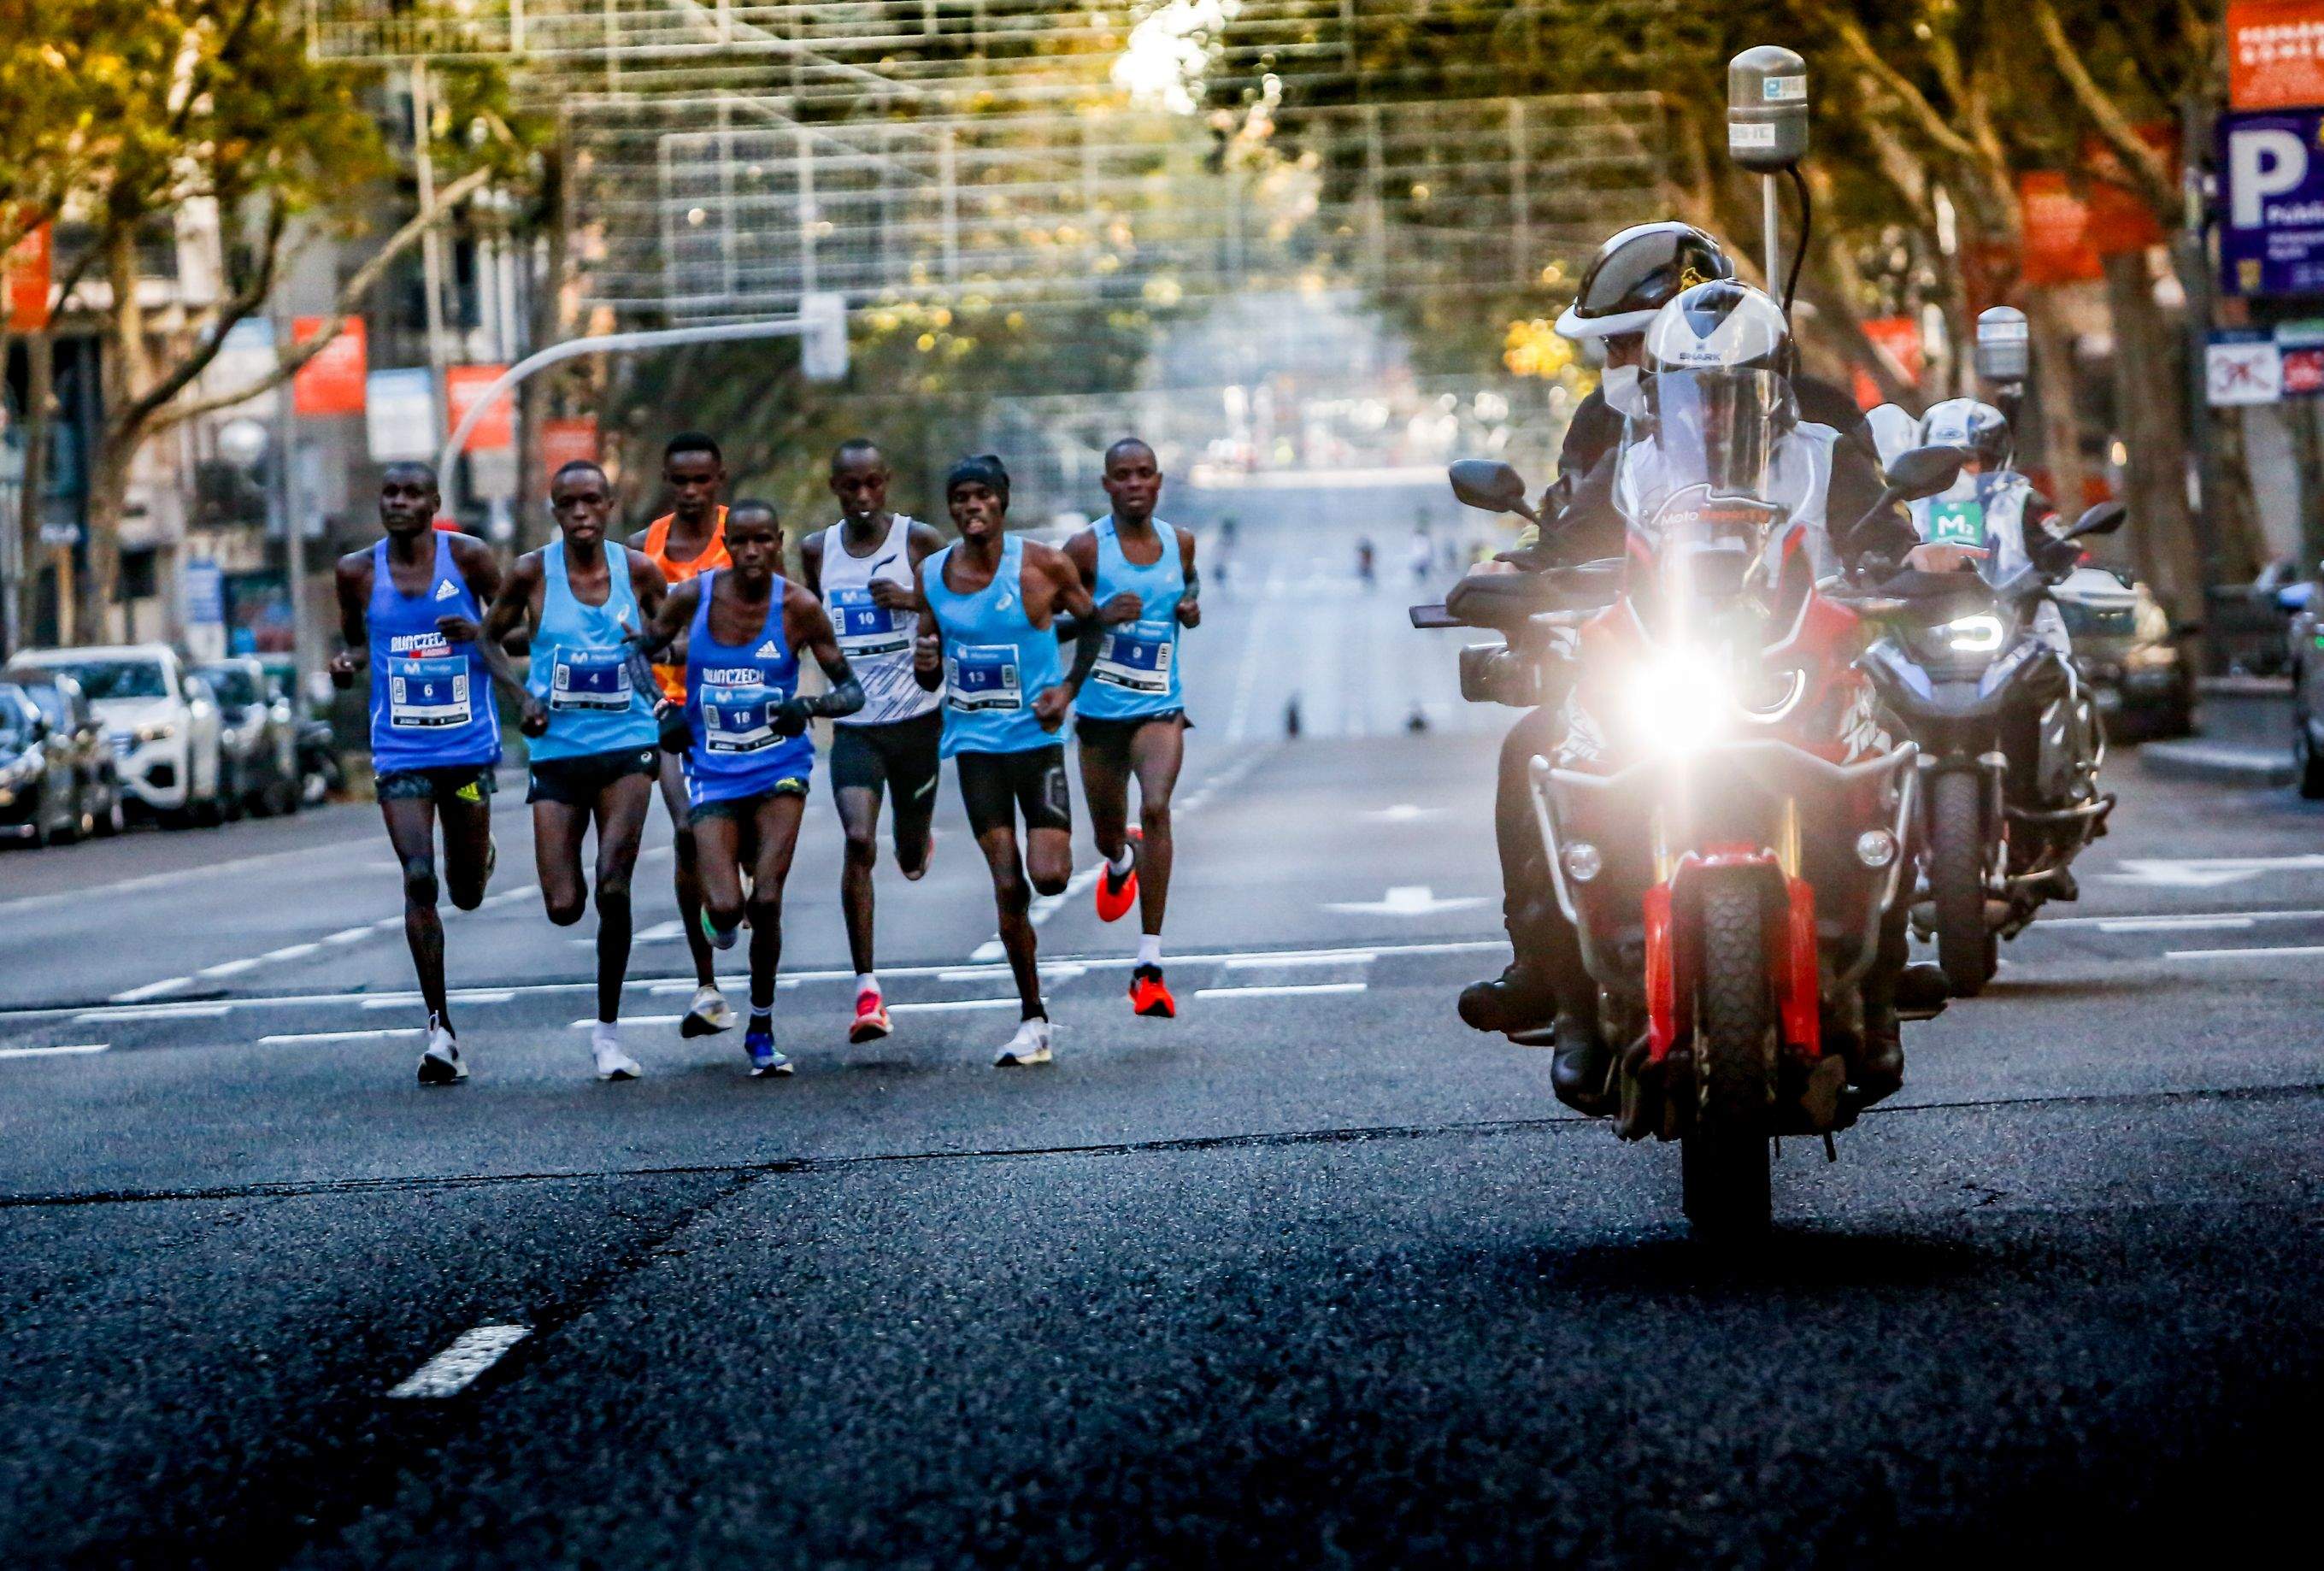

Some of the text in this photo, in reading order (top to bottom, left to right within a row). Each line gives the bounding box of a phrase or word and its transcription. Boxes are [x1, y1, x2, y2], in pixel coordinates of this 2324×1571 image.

[2228, 129, 2307, 229] P
[1680, 351, 1721, 361] SHARK
[858, 612, 874, 625] 10
[1133, 646, 1142, 659] 9
[590, 673, 598, 684] 4
[968, 671, 985, 683] 13
[424, 684, 433, 697] 6
[733, 711, 750, 725] 18
